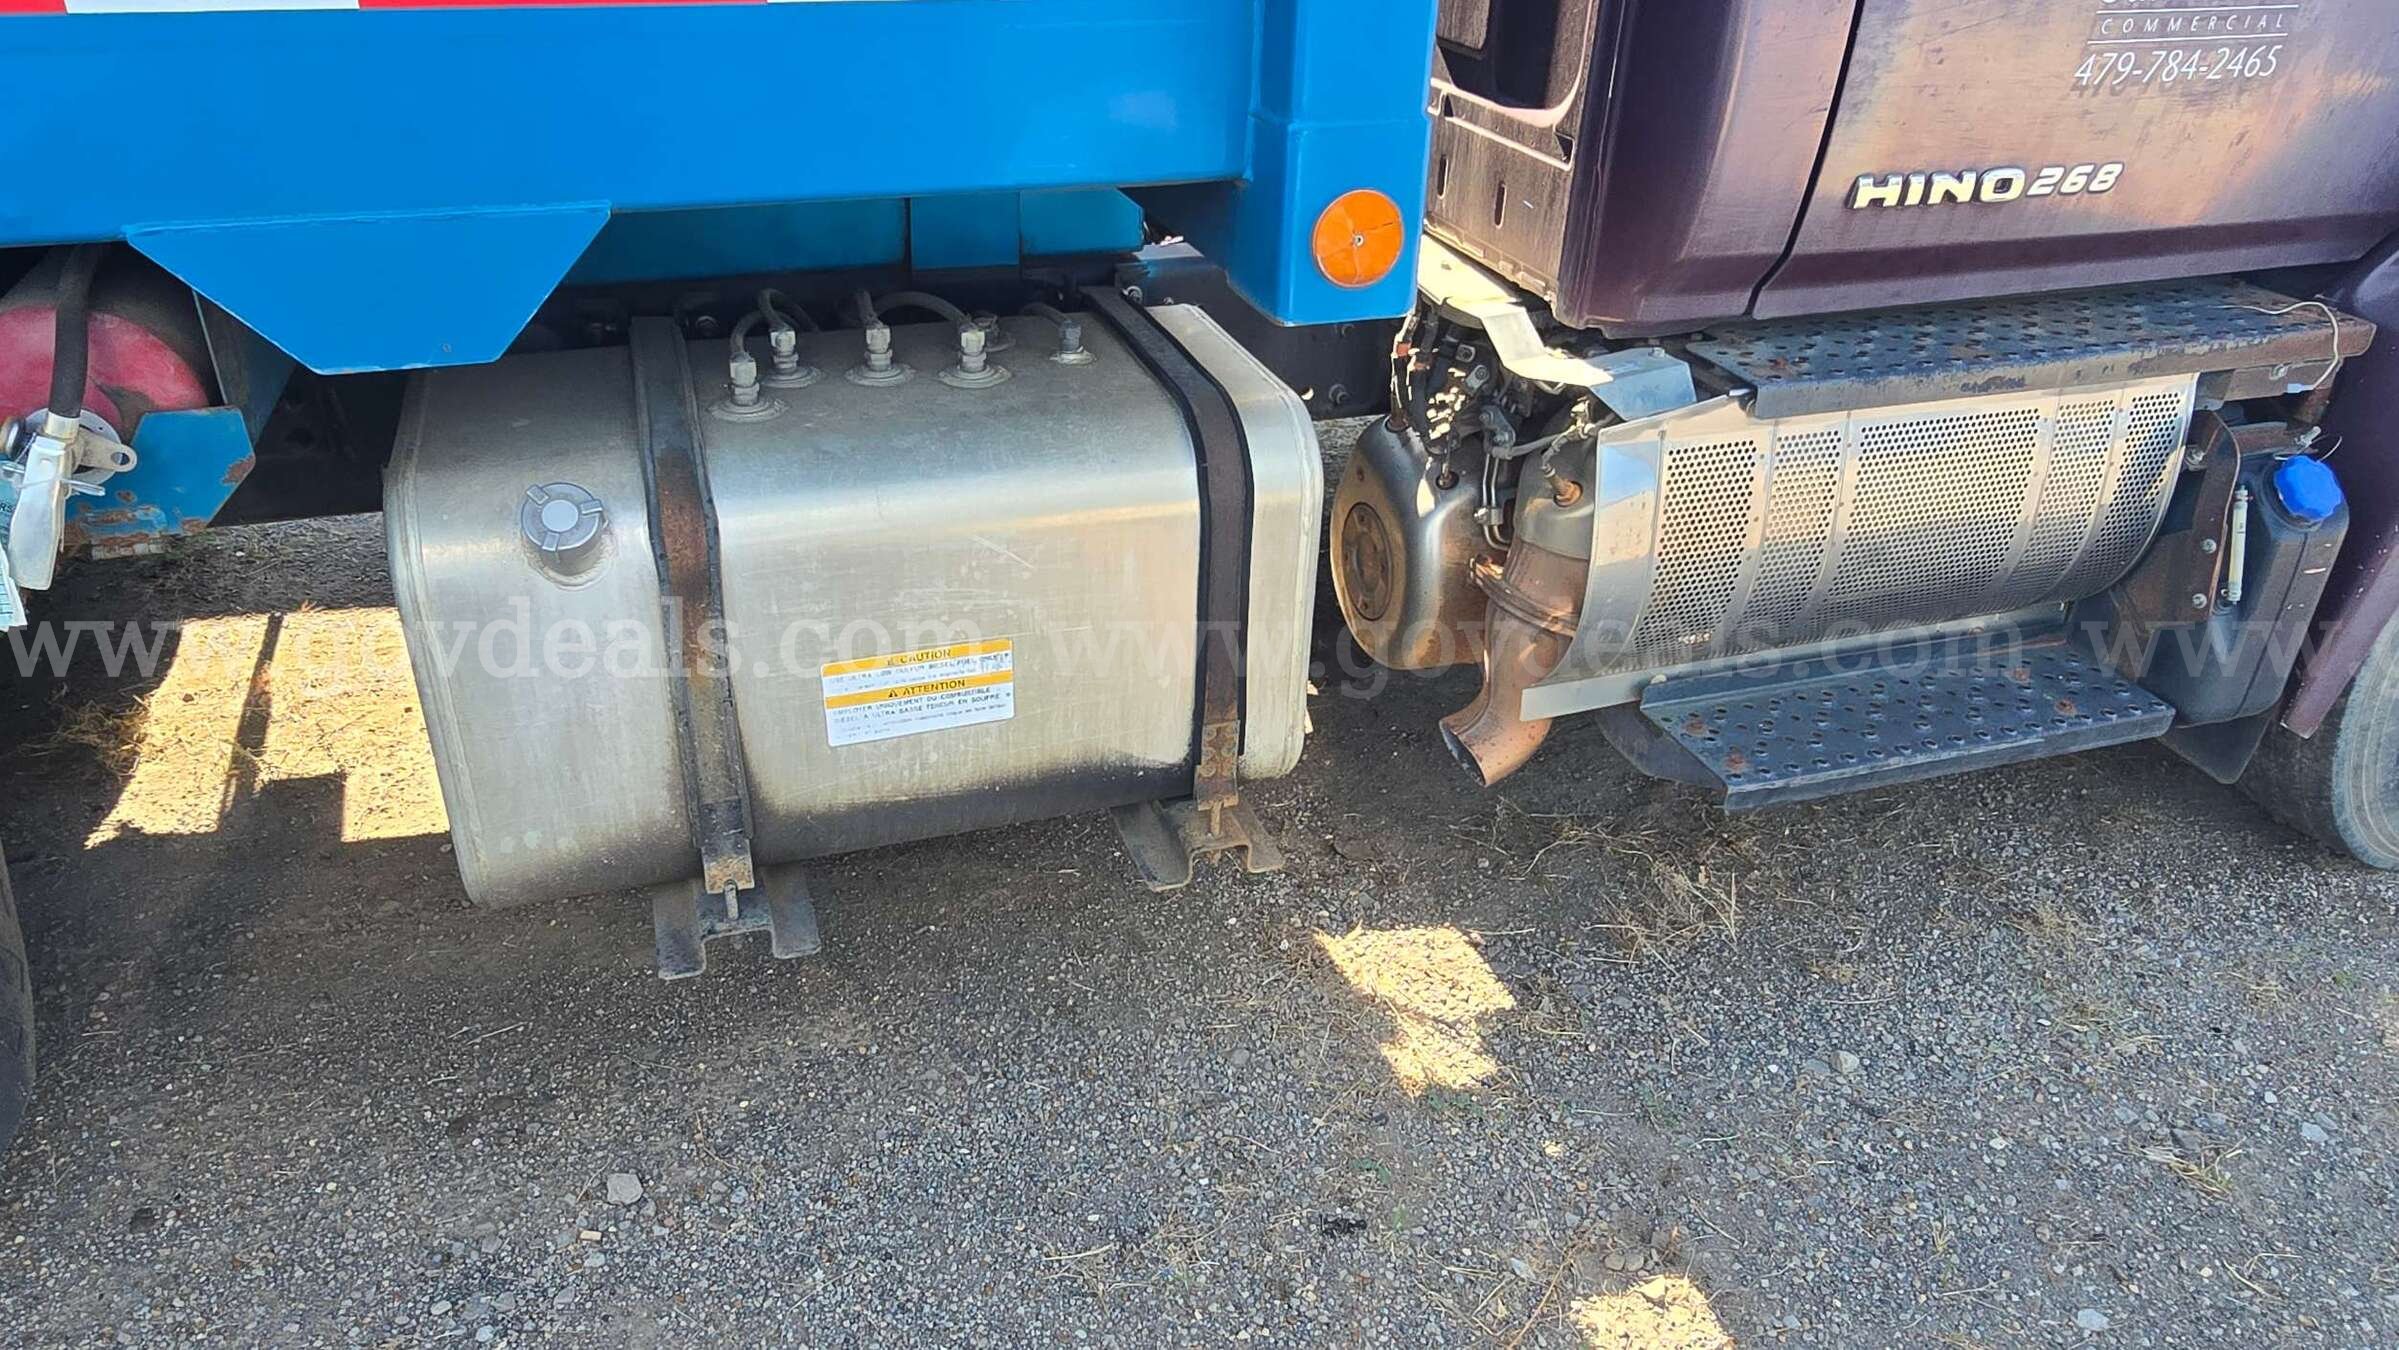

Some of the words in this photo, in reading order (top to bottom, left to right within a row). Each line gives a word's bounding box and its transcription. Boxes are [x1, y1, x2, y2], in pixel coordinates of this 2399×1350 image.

[2100, 13, 2283, 35] COMMERCIAL
[2074, 44, 2283, 86] 479-784-2465
[1850, 166, 2026, 210] HINO
[2025, 160, 2124, 197] 268
[898, 647, 952, 664] CAUTION
[901, 678, 966, 696] ATTENTION
